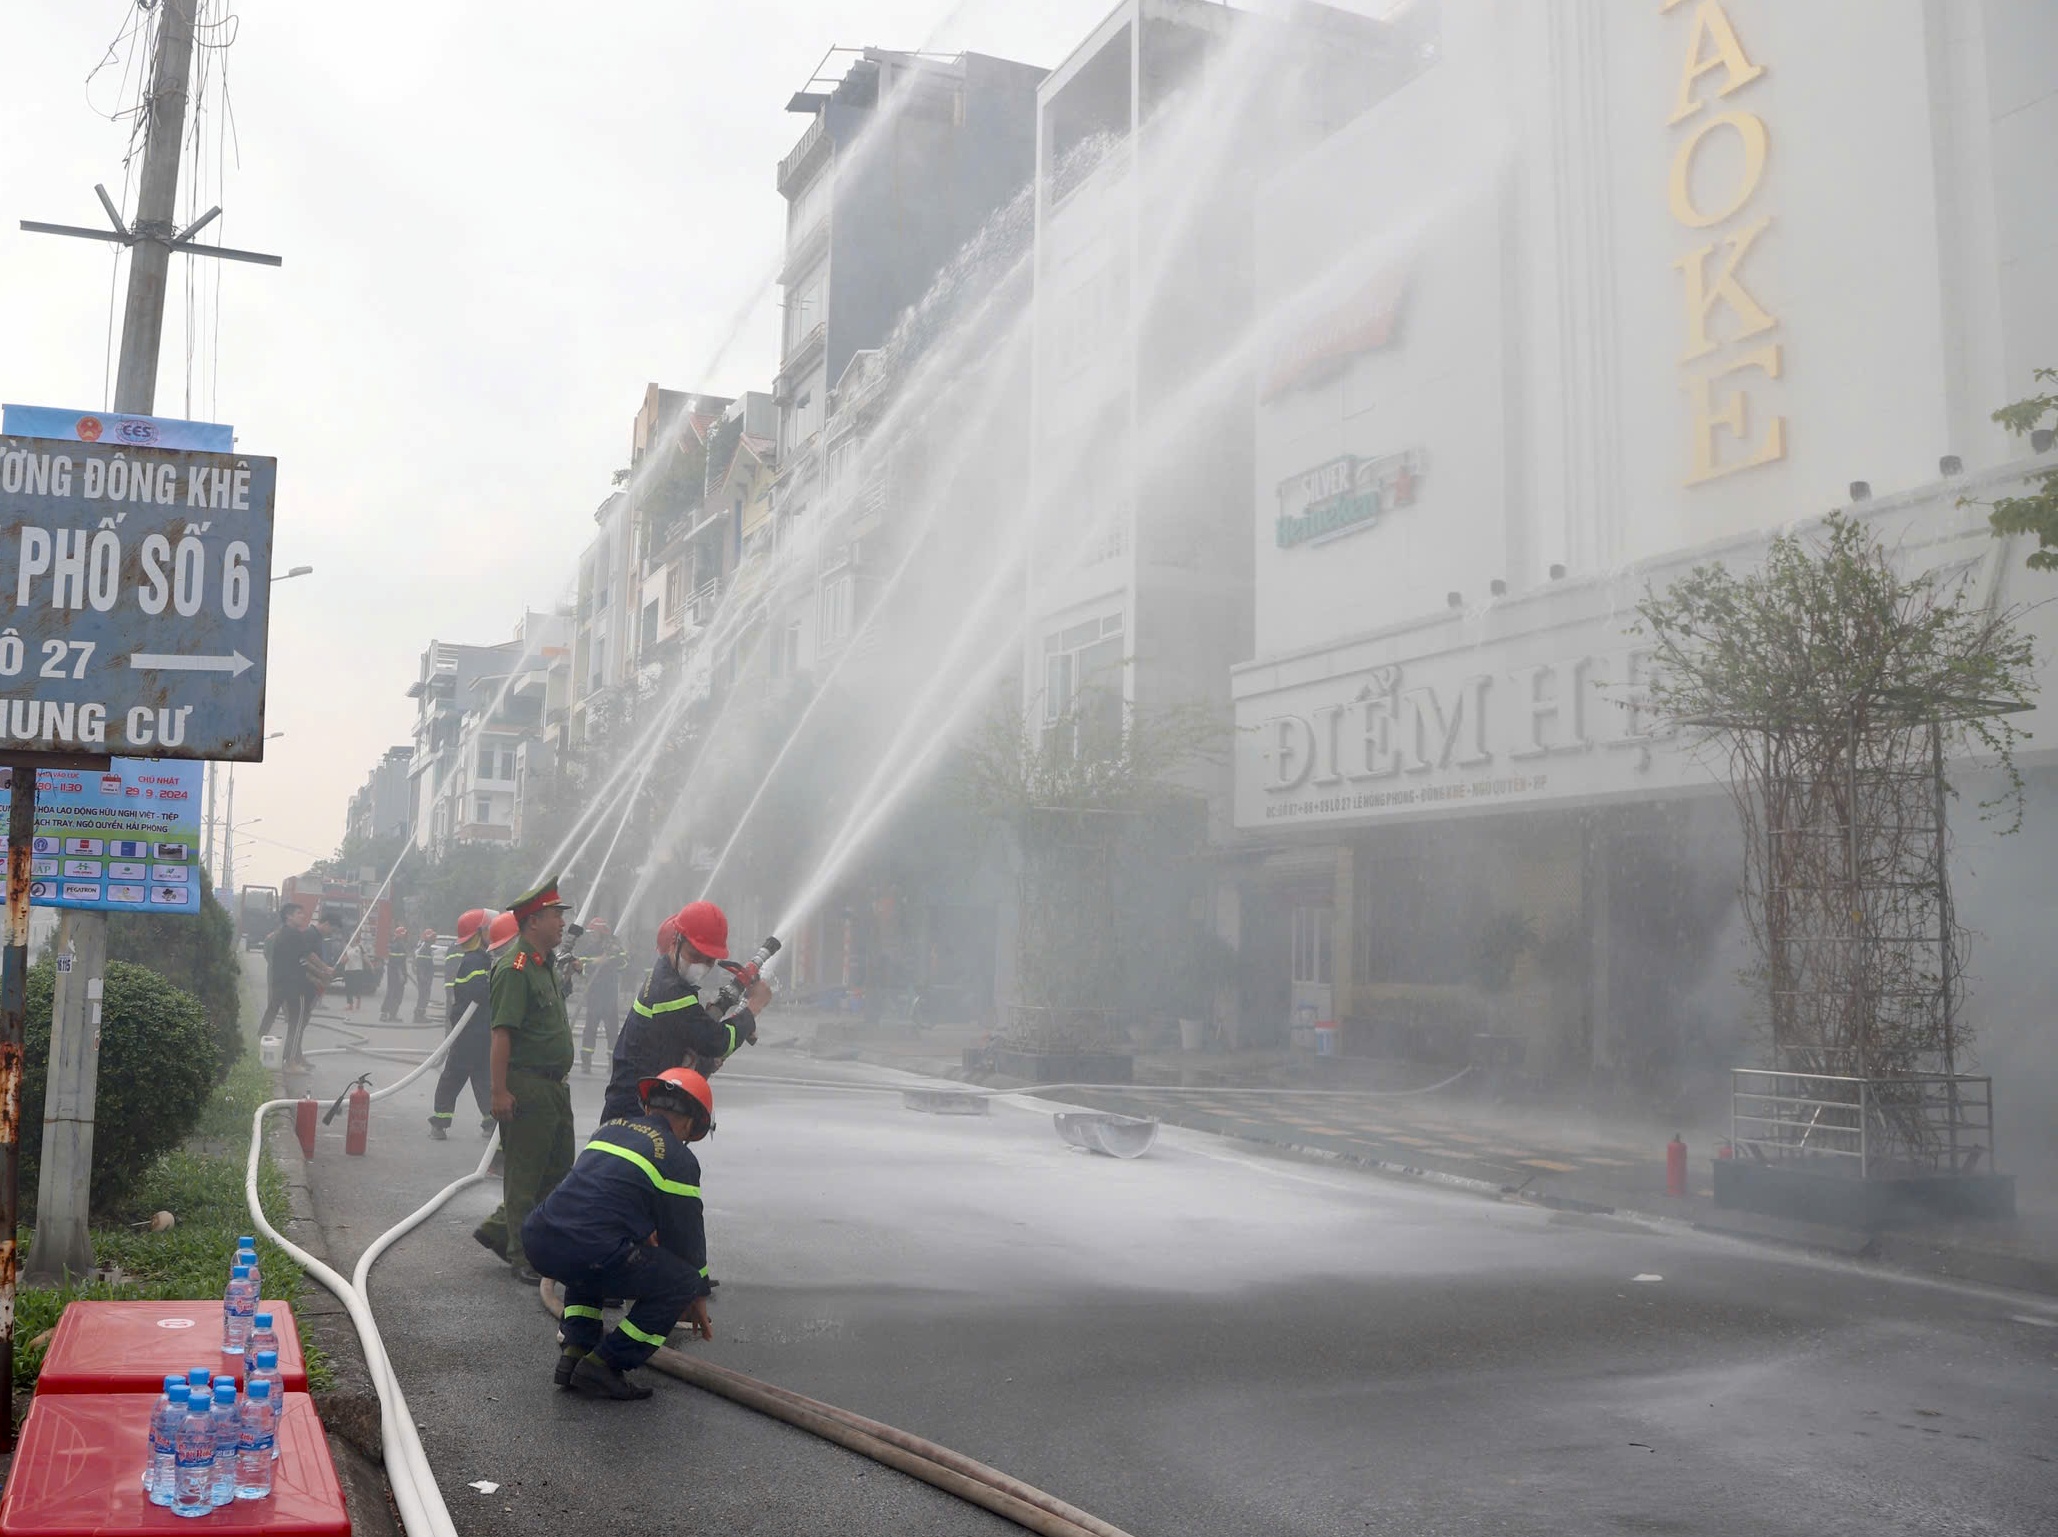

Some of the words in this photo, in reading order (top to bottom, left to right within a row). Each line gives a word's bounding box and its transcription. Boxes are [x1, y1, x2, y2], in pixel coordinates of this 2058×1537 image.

[1659, 0, 1788, 488] AOKE
[0, 439, 73, 498] ỜNG
[84, 452, 178, 506] ĐÔNG
[187, 460, 252, 511] KHÊ
[1302, 461, 1351, 505] SILVER
[16, 512, 127, 613] PHỐ
[138, 521, 212, 618] SỐ
[222, 540, 251, 620] 6
[39, 639, 96, 680] 27
[126, 704, 194, 748] CƯ
[1262, 664, 1494, 793] ĐIỂM
[1508, 645, 1685, 774] HẸ
[56, 807, 72, 815] LAO
[125, 786, 140, 796] 29
[159, 790, 188, 799] 2024
